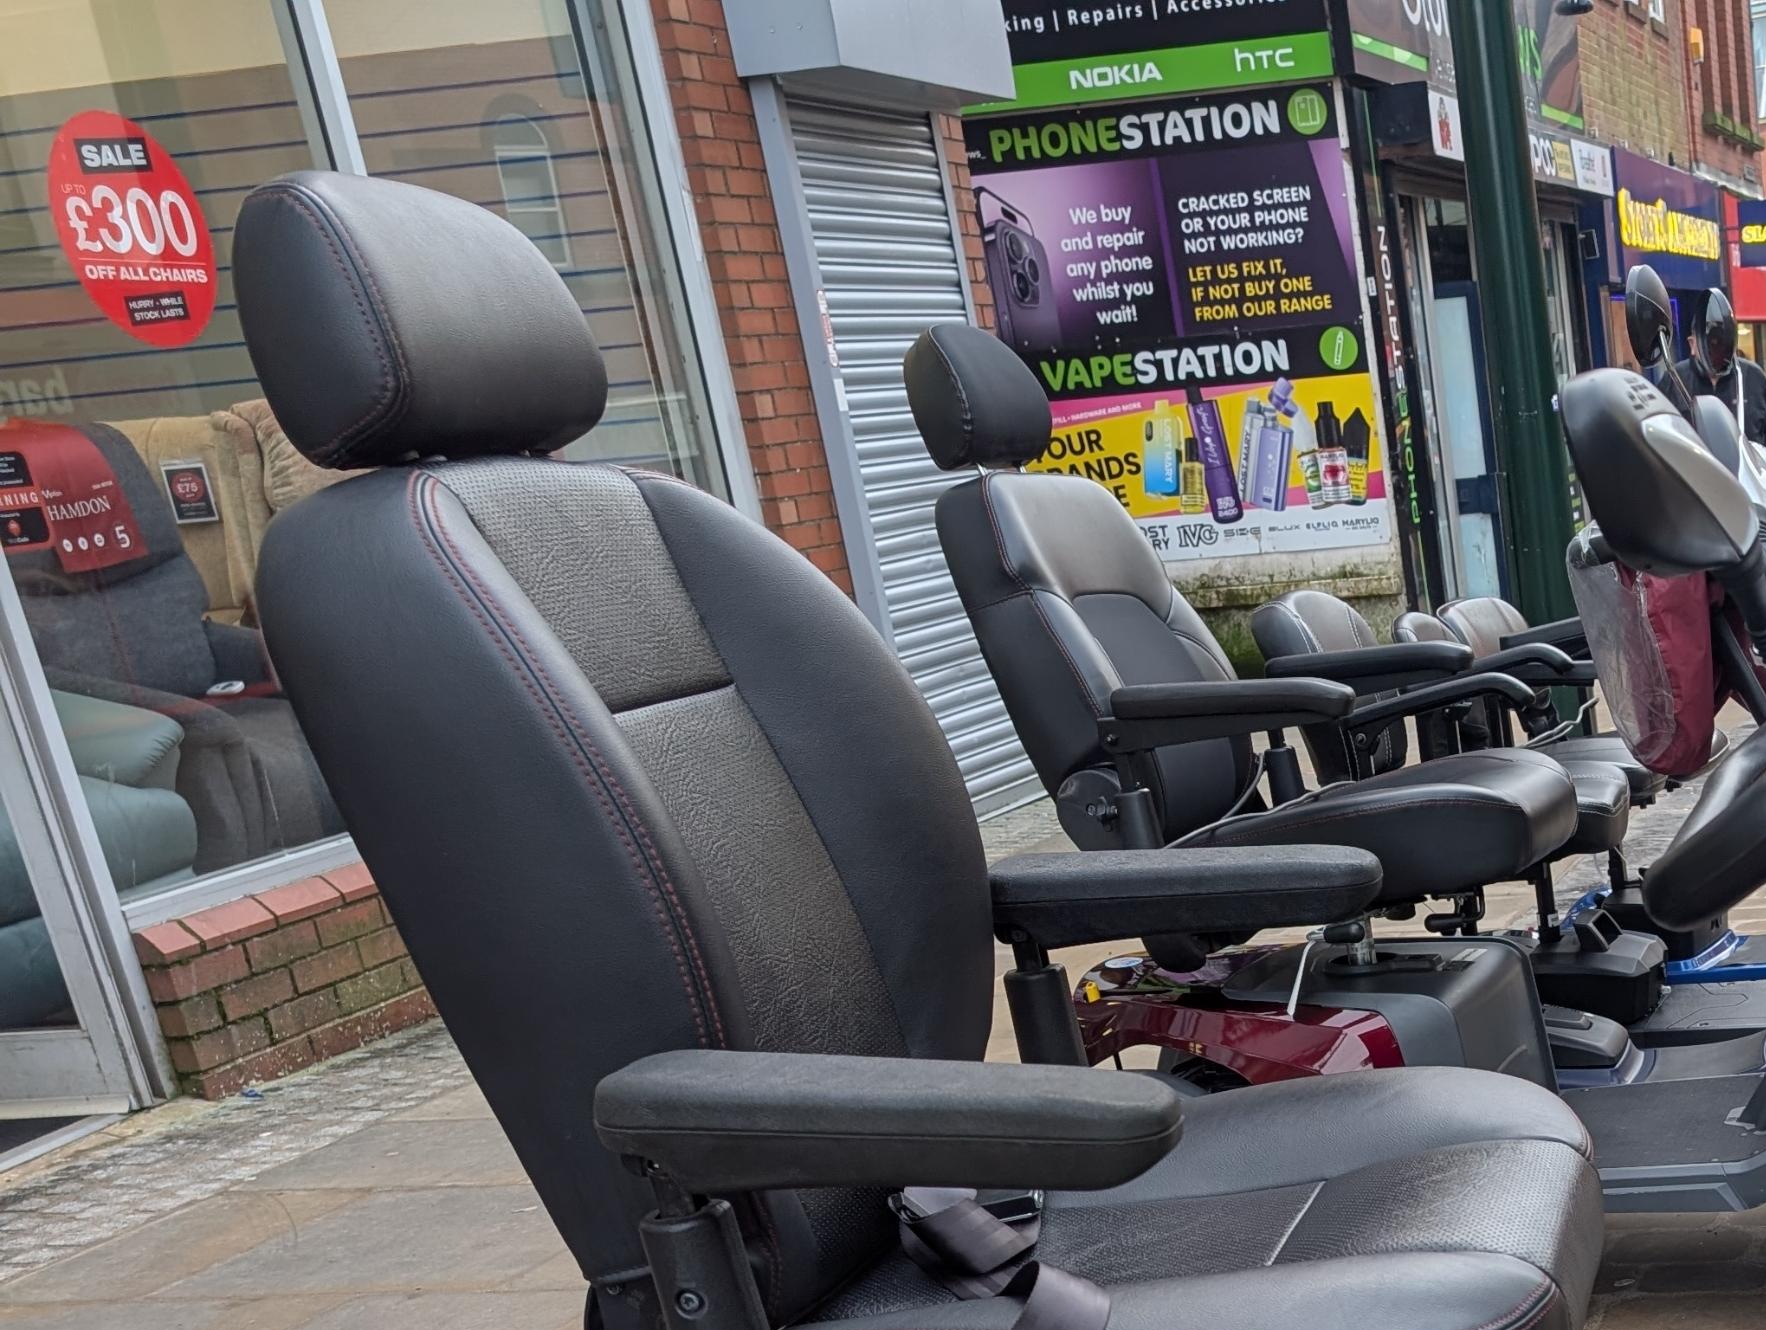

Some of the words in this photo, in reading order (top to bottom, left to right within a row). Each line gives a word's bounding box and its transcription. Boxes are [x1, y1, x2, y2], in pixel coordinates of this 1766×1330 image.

[1067, 5, 1144, 26] Repairs
[1069, 62, 1163, 90] NOKIA
[989, 99, 1281, 163] PHONESTATION
[80, 144, 147, 168] SALE
[1178, 191, 1249, 213] CRACKED
[1253, 185, 1311, 206] SCREEN
[66, 184, 198, 257] £300
[1069, 207, 1097, 225] We
[1100, 203, 1131, 224] buy
[1181, 218, 1204, 233] OR
[1206, 212, 1250, 231] YOUR
[1254, 207, 1309, 227] PHONE
[1061, 231, 1093, 252] and
[1097, 226, 1145, 252] repair
[1183, 236, 1217, 254] NOT
[1220, 227, 1304, 250] WORKING?
[84, 264, 117, 280] OFF
[119, 265, 149, 281] ALL
[149, 266, 208, 283] CHAIRS
[1066, 260, 1097, 279] any
[1100, 254, 1153, 278] phone
[1188, 265, 1213, 282] LET
[1216, 262, 1238, 279] US
[1242, 259, 1266, 277] FIX
[1270, 258, 1287, 275] IT,
[1072, 280, 1120, 302] whilst
[1123, 281, 1154, 302] you
[1191, 286, 1205, 302] IF
[1208, 283, 1240, 300] NOT
[1245, 279, 1276, 297] BUY
[1280, 276, 1313, 293] ONE
[1096, 304, 1138, 325] wait!
[1194, 304, 1239, 322] FROM
[1242, 300, 1276, 317] OUR
[1280, 294, 1333, 314] RANGE
[1040, 338, 1290, 393] VAPESTATION
[1036, 429, 1104, 464] OUR
[1034, 452, 1141, 482] ANDS
[47, 495, 111, 521] HAMDON
[115, 524, 131, 549] 5
[1153, 538, 1169, 551] RY
[1176, 523, 1219, 548] IVG
